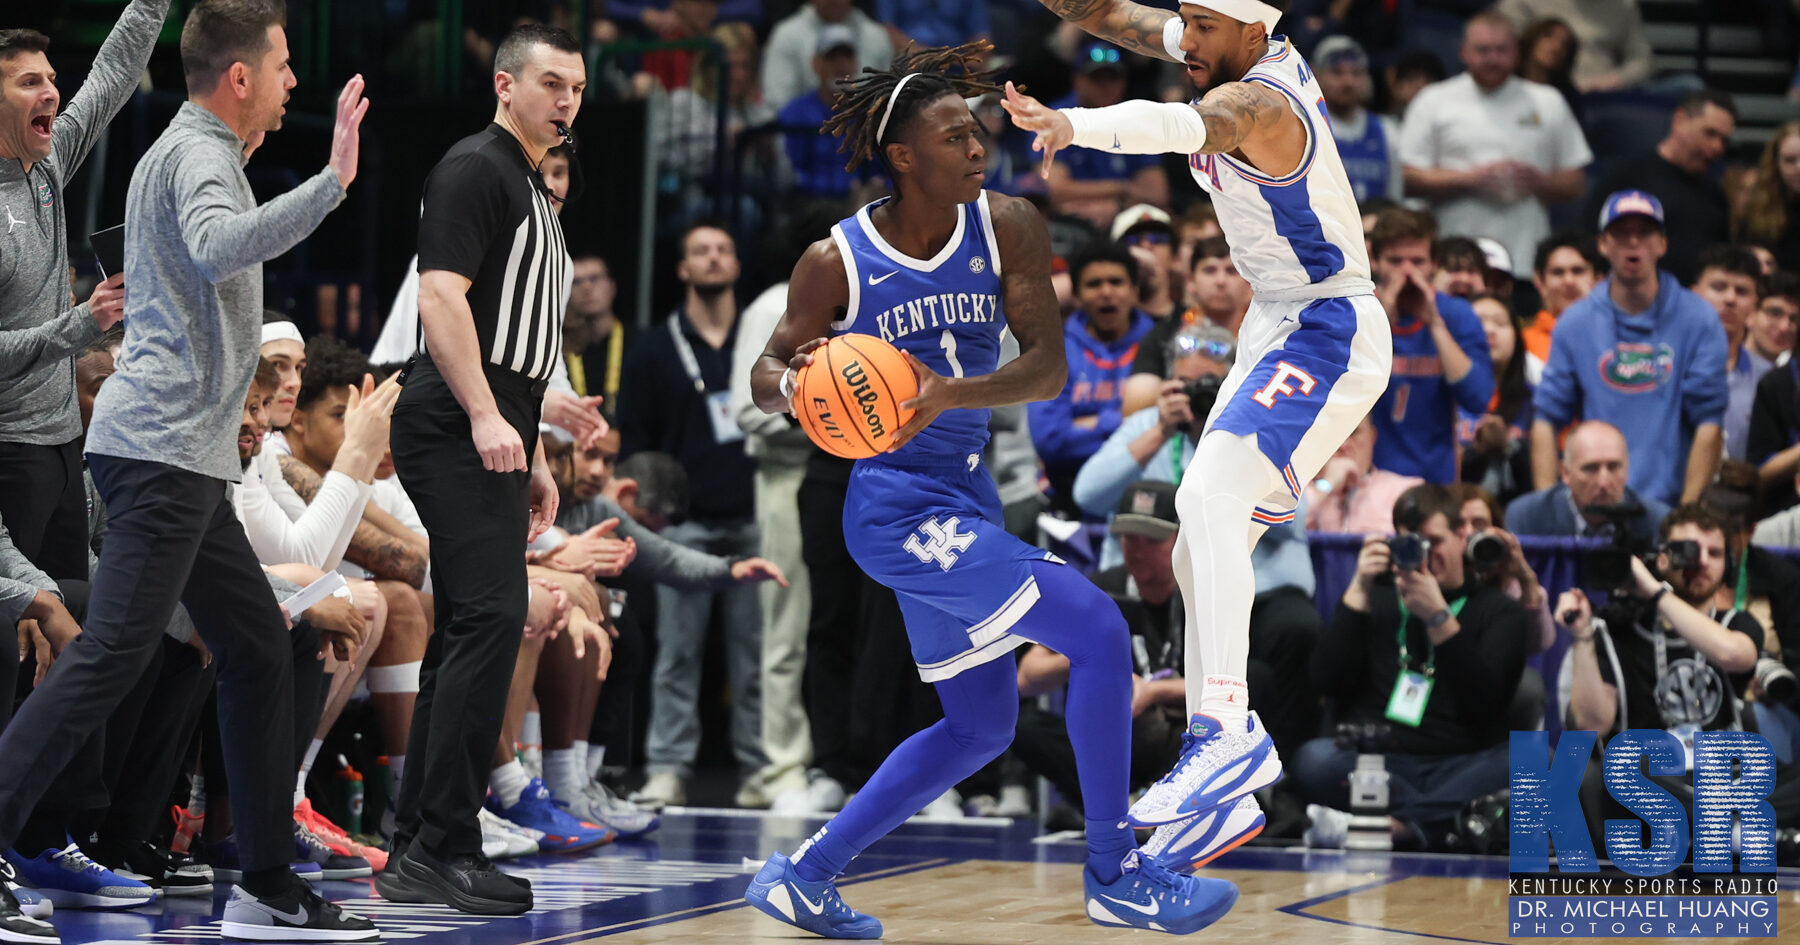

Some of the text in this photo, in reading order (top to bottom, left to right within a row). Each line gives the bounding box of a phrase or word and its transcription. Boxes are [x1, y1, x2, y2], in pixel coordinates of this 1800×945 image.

[969, 257, 985, 273] SEC
[876, 292, 997, 343] KENTUCKY
[940, 329, 964, 378] 1
[842, 360, 885, 440] Wilson
[1251, 360, 1318, 409] F
[903, 516, 978, 572] UK
